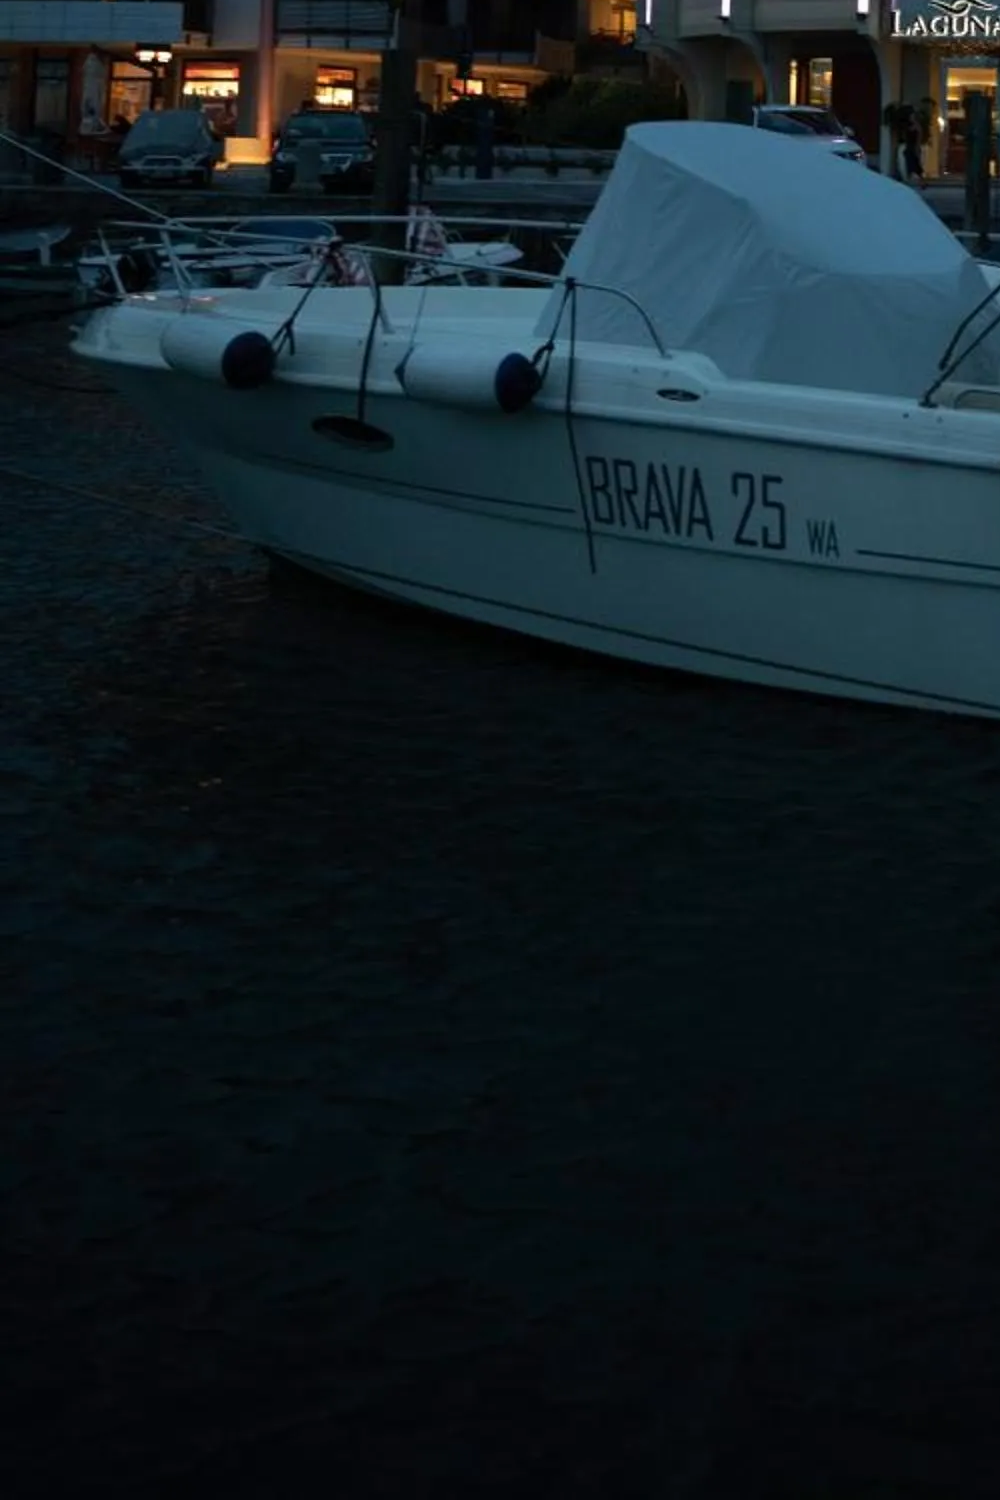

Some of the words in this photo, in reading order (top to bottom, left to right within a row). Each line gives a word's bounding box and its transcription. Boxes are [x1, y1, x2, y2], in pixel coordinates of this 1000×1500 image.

[585, 455, 714, 542] BRAVA
[731, 472, 787, 550] 25
[806, 518, 841, 558] WA
